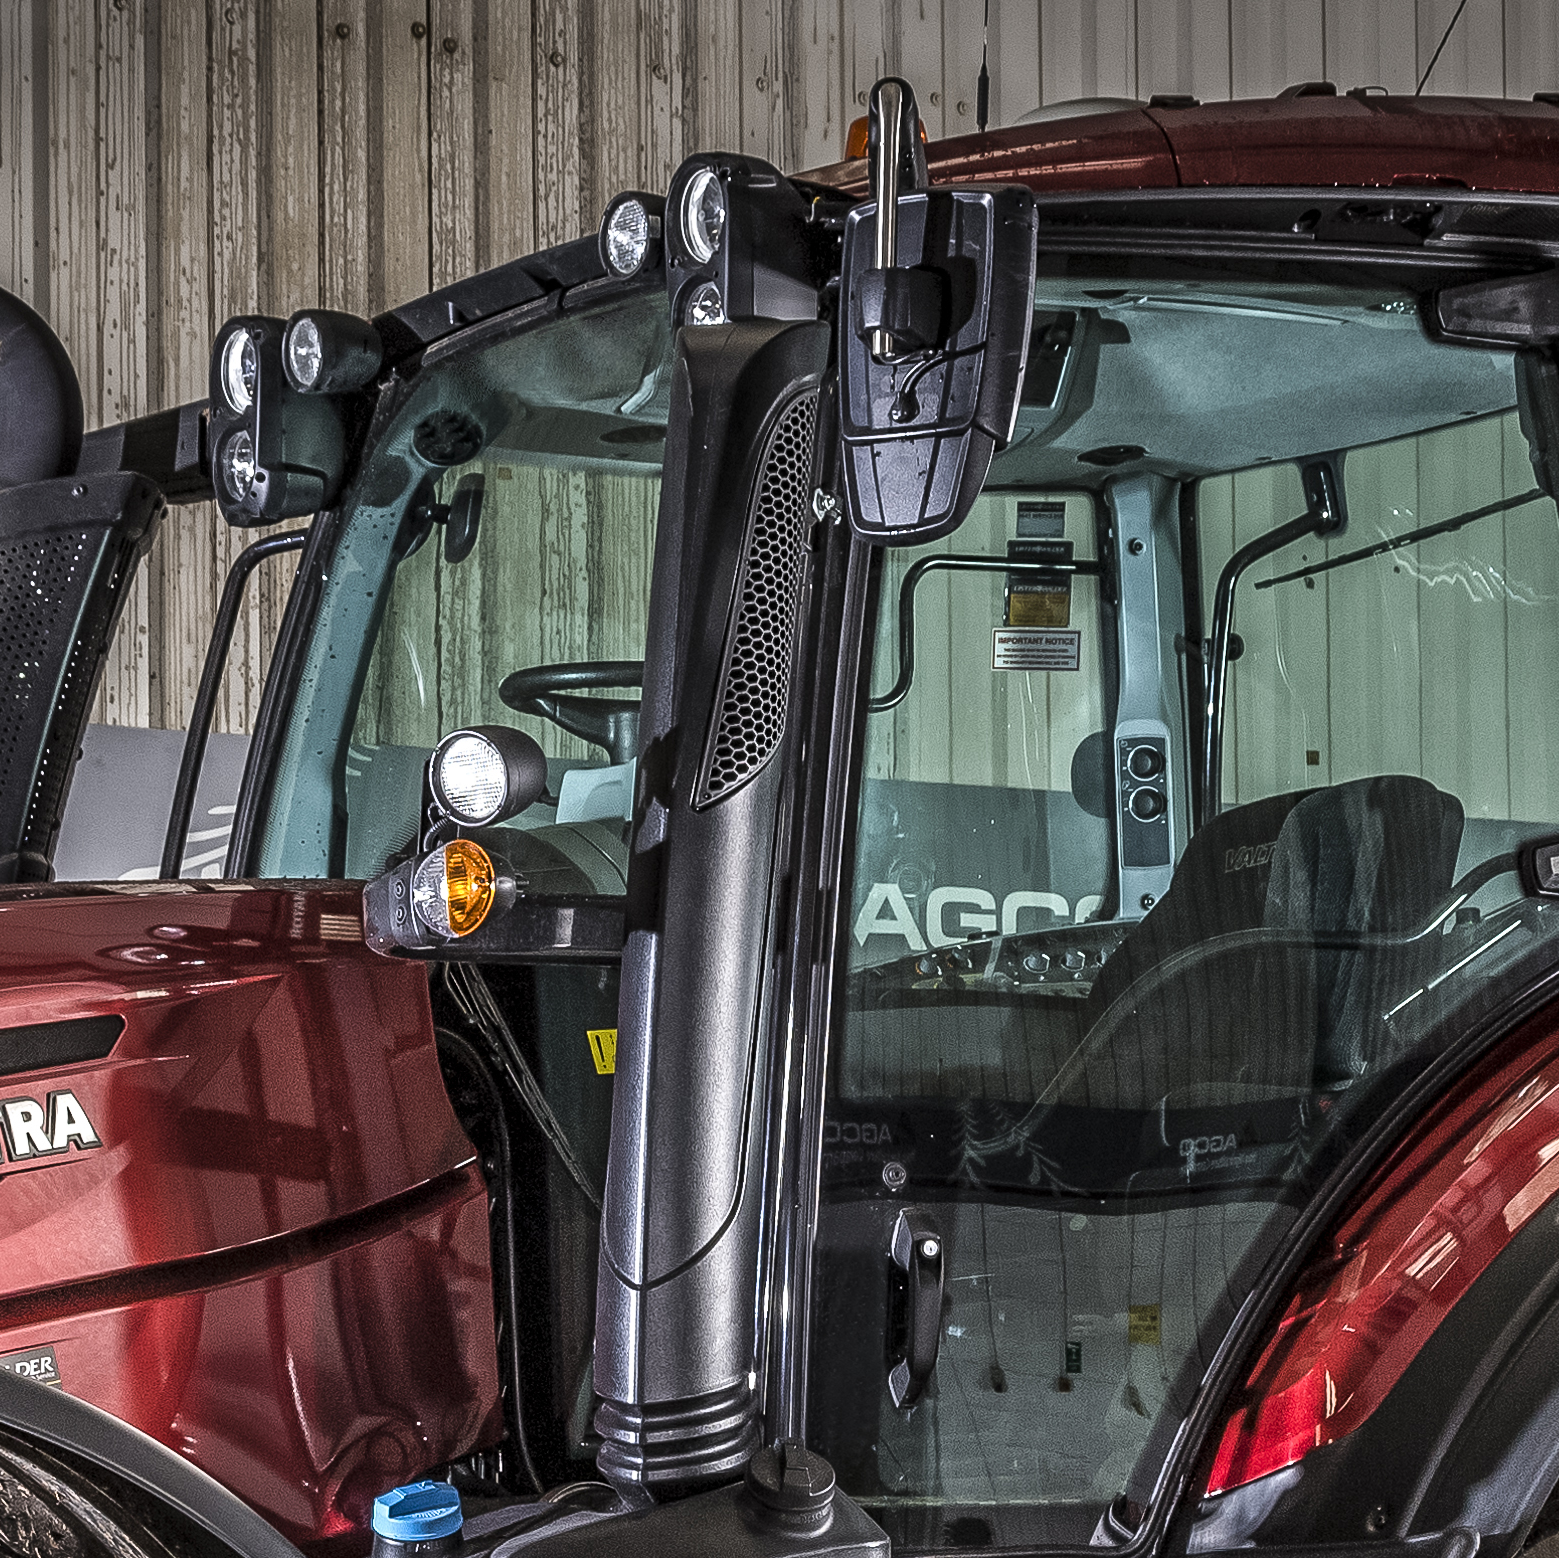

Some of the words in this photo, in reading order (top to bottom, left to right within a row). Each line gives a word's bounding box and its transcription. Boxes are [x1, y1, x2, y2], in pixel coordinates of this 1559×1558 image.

[998, 636, 1043, 645] IMPORTANT
[1045, 637, 1076, 646] NOTICE
[1225, 841, 1278, 874] VALT
